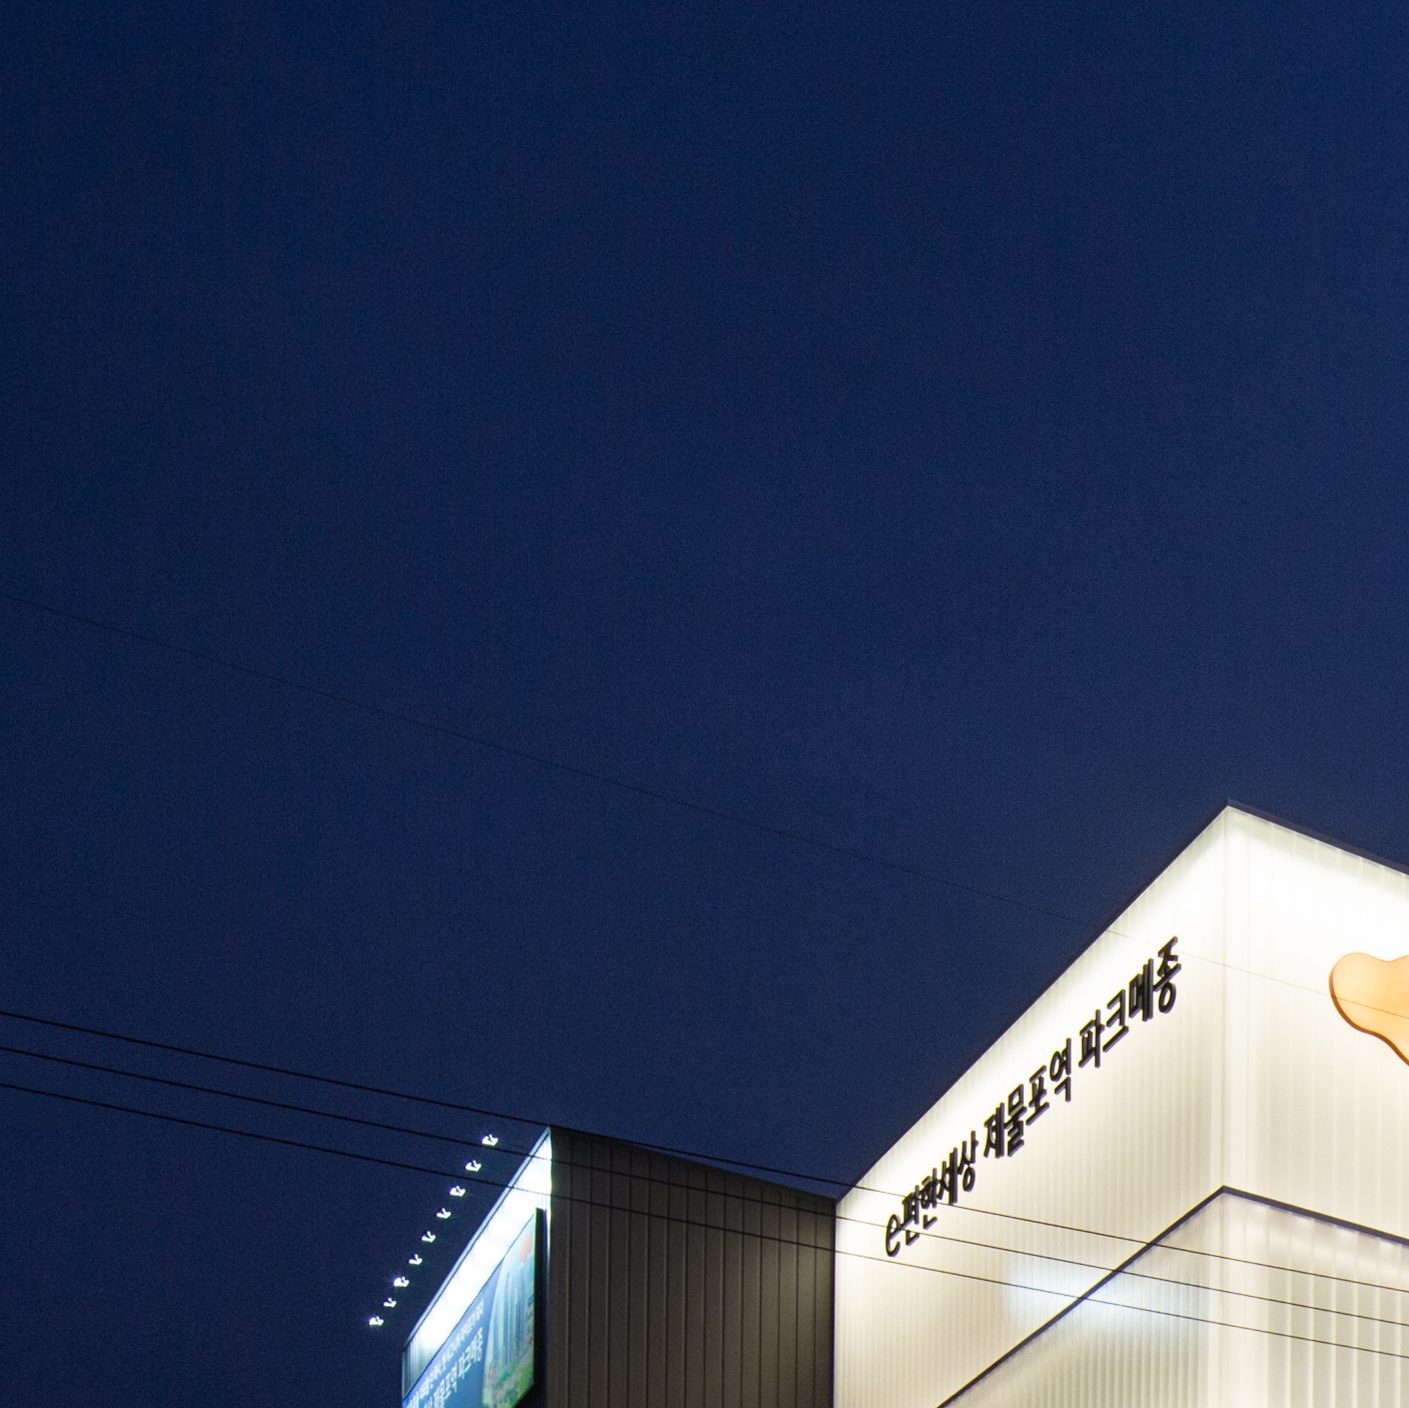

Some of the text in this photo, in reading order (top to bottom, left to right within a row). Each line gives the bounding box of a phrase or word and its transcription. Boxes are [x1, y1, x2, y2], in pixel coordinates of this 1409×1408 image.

[885, 936, 1181, 1257] e편한세상 제물포역 파크메종
